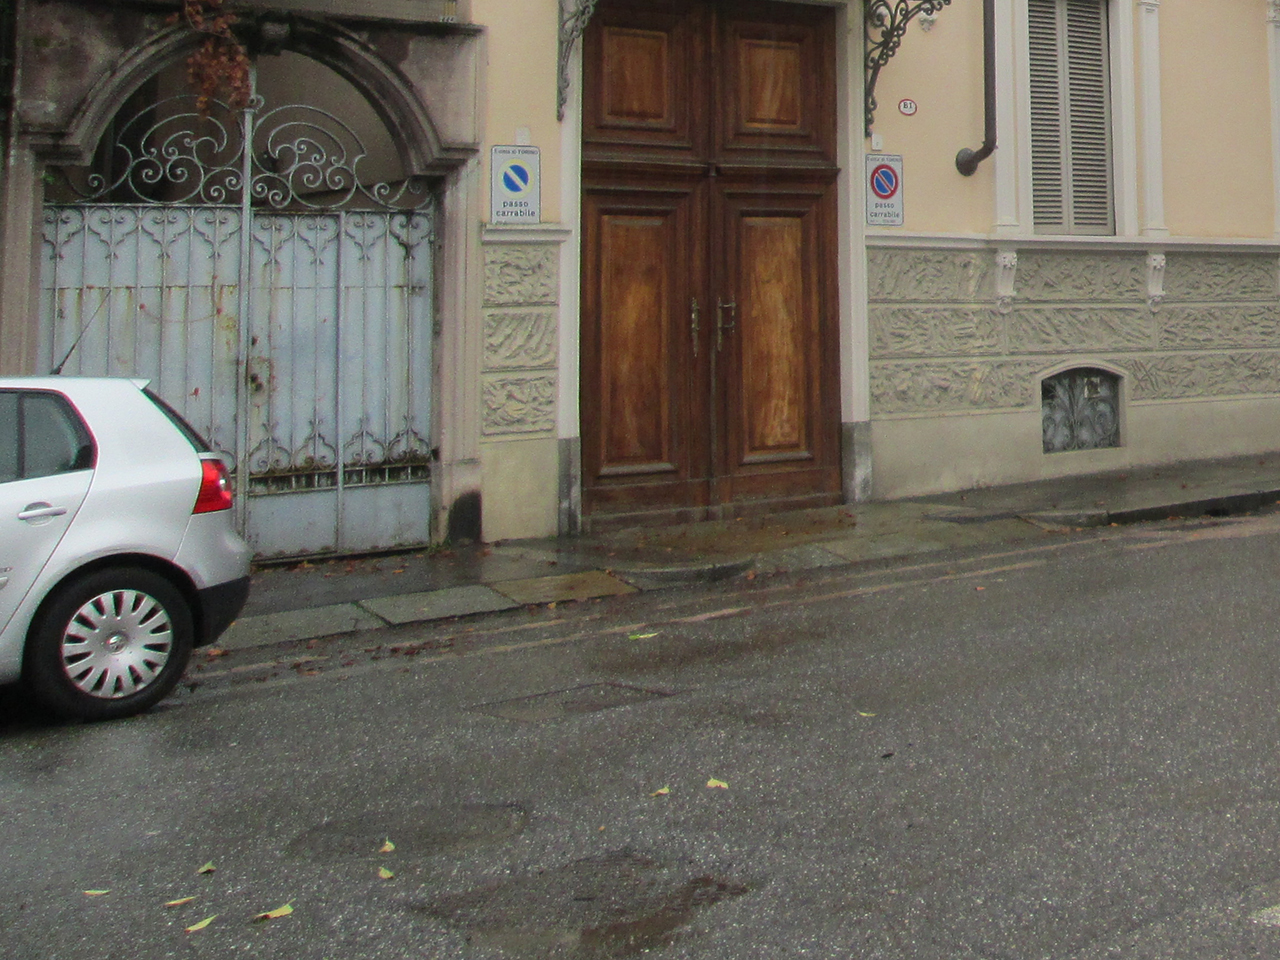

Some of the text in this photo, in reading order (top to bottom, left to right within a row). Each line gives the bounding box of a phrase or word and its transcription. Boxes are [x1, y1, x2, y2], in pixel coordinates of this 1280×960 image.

[502, 200, 529, 208] passo
[495, 208, 536, 217] carrabile
[869, 210, 900, 218] carrabile
